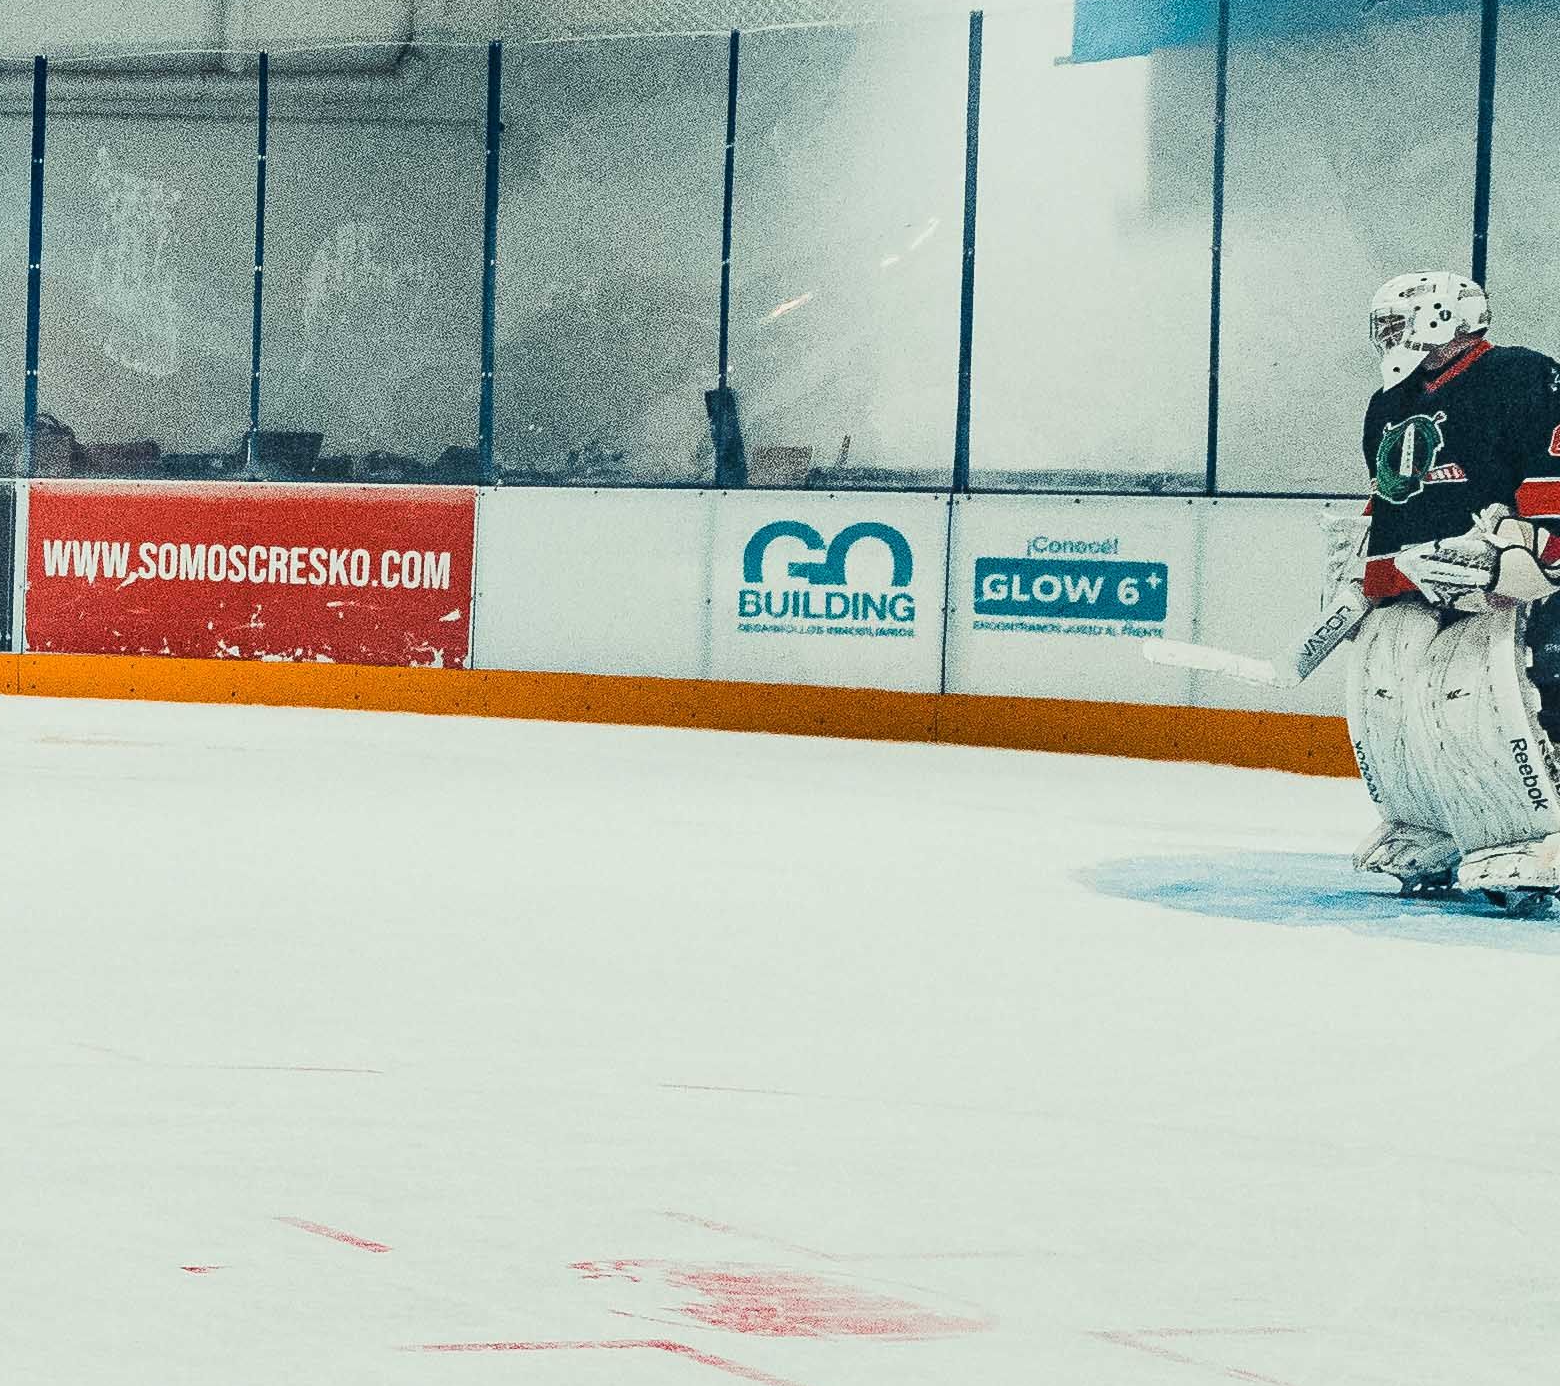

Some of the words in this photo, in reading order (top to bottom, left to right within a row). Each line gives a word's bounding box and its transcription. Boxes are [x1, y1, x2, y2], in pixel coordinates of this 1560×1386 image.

[42, 539, 452, 590] WWW.SOMOSCRESKO.COM
[737, 588, 916, 622] BUILDING
[982, 573, 1105, 604] GLOW
[1510, 737, 1549, 812] Reebok
